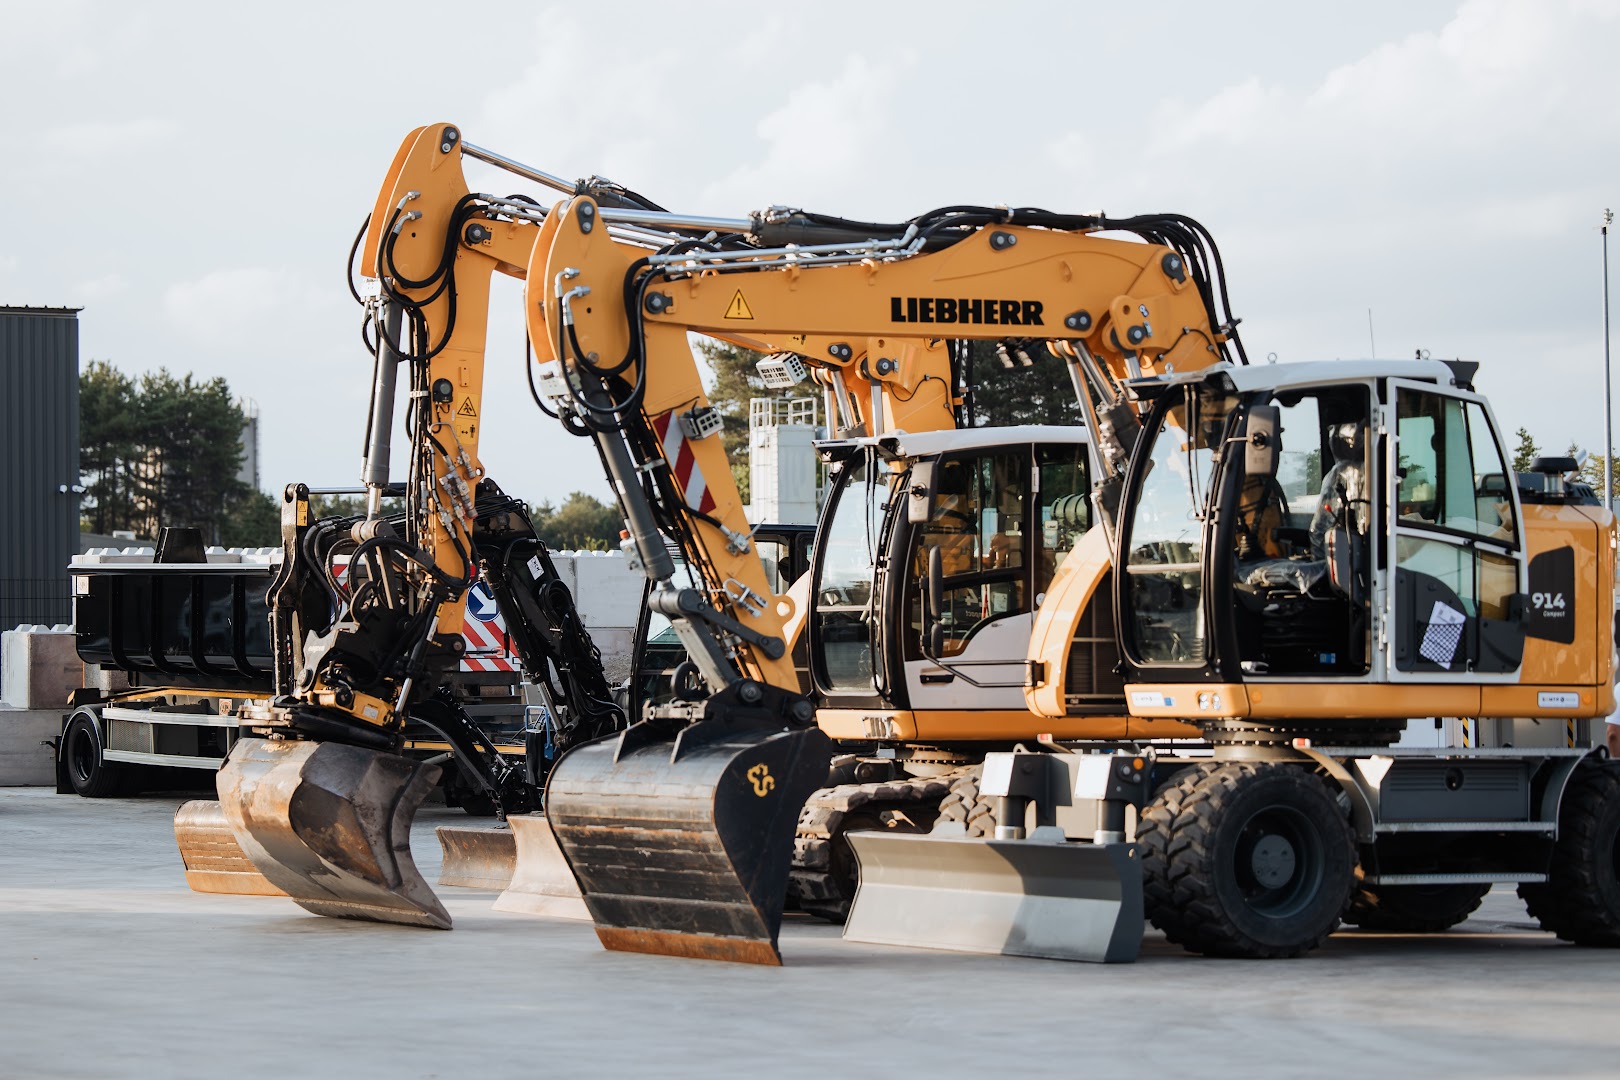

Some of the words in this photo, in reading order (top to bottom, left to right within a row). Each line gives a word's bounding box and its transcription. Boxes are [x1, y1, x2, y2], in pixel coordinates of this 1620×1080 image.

[890, 297, 1045, 326] LIEBHERR
[1532, 592, 1565, 609] 914
[1543, 610, 1565, 618] Compact
